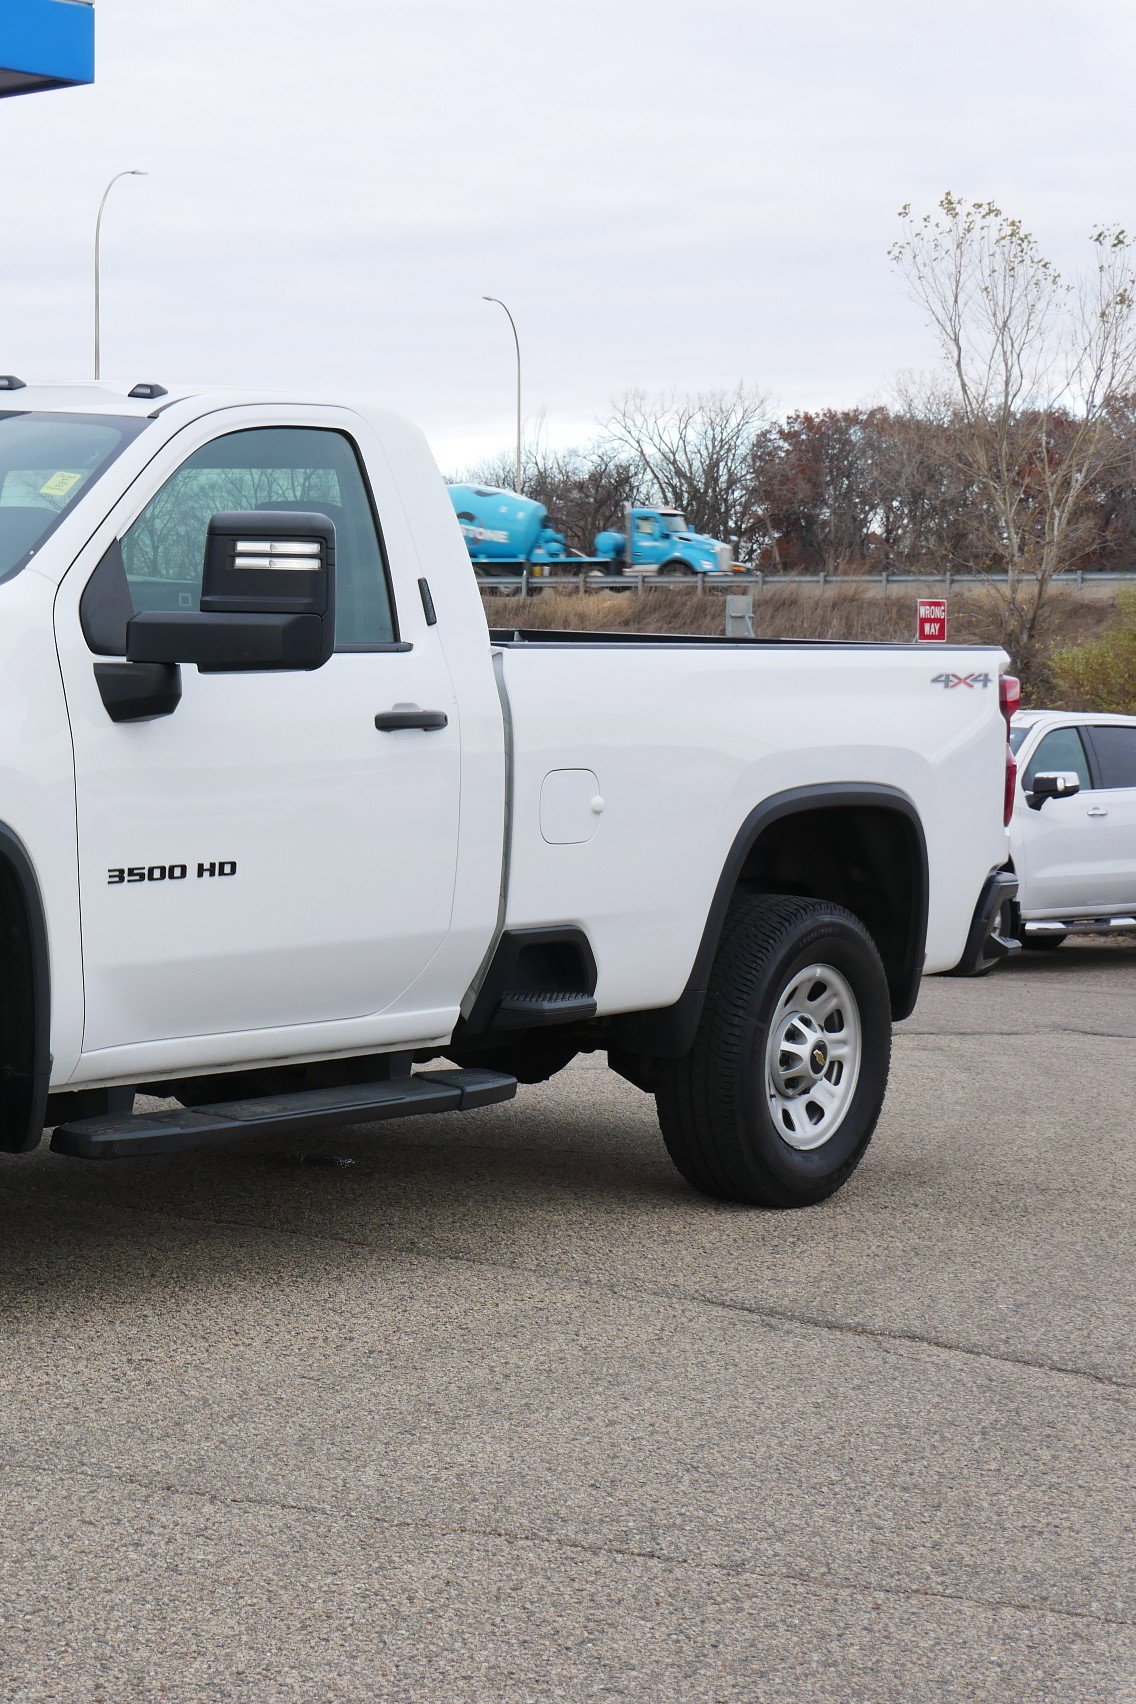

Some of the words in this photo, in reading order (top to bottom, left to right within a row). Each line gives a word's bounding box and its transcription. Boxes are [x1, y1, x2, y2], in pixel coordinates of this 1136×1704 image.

[919, 606, 945, 619] WRONG
[924, 622, 940, 635] WAY
[107, 864, 187, 885] 3500
[197, 861, 237, 878] HD
